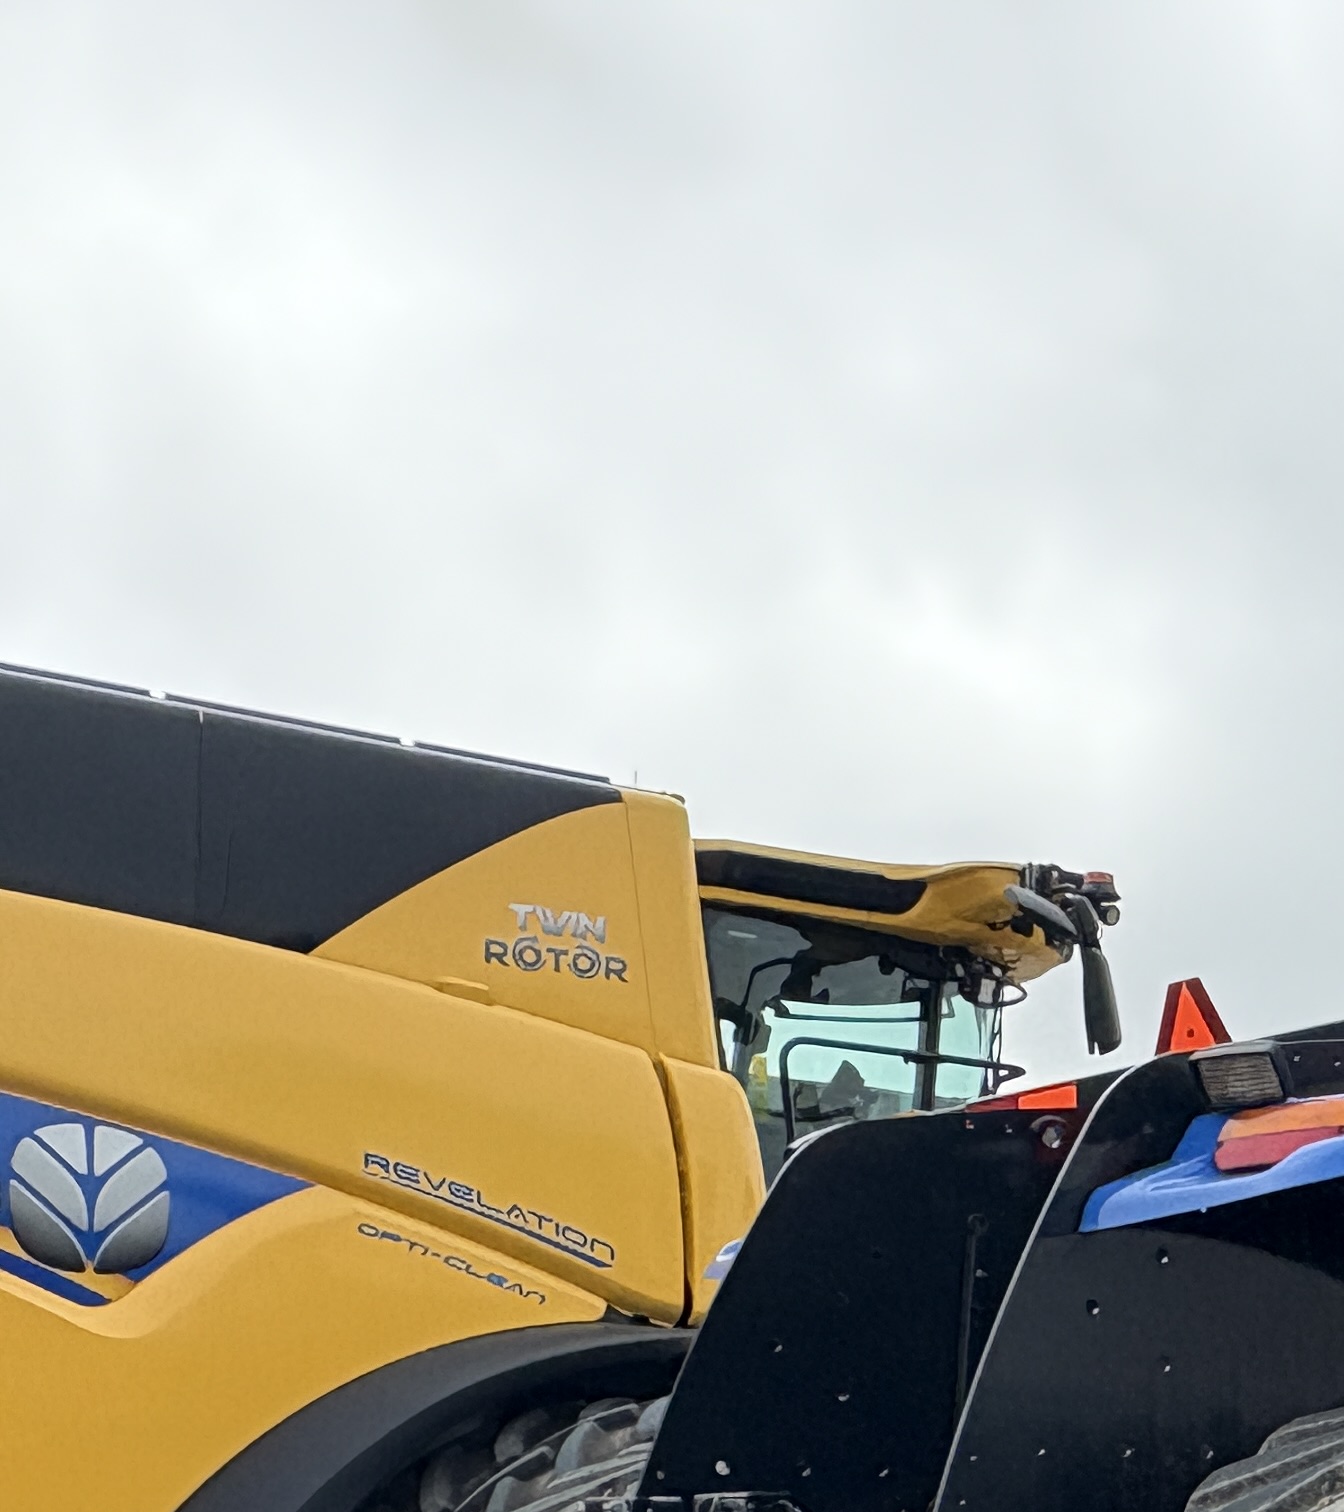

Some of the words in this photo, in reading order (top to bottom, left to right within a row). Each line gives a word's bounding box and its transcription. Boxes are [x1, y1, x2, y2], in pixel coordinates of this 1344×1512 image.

[508, 902, 606, 944] TWIN
[484, 936, 629, 983] ROTOR
[363, 1152, 615, 1262] REVELATION
[357, 1222, 546, 1304] OPTI-CLEAN
